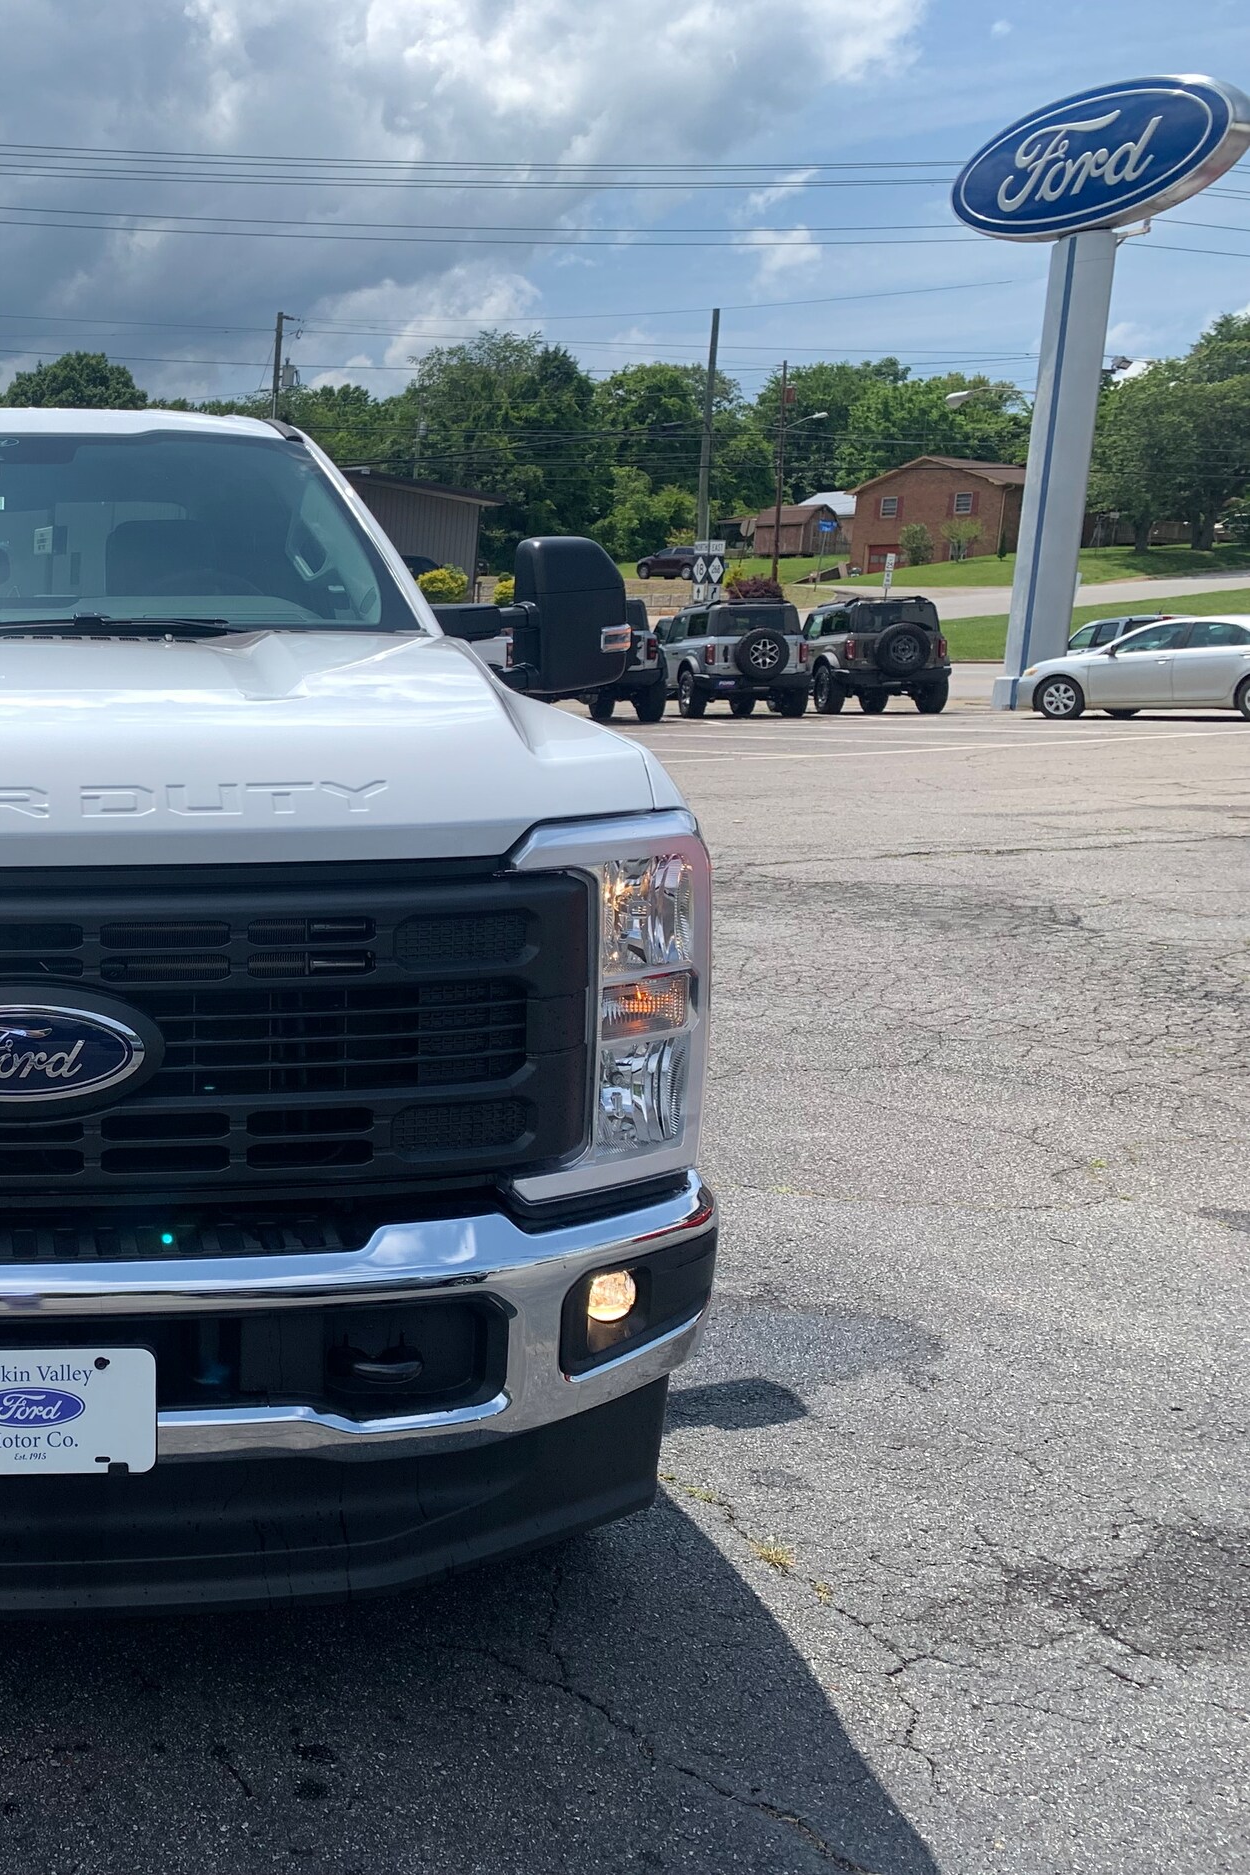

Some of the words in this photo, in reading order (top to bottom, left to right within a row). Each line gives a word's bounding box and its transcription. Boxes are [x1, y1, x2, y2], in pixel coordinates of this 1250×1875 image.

[997, 109, 1164, 213] Ford
[711, 543, 724, 552] EAST
[696, 563, 704, 576] 18
[78, 779, 389, 818] DUTY
[36, 1364, 94, 1387] Valley
[46, 1431, 79, 1448] Co.
[13, 1452, 28, 1461] Est.
[29, 1452, 47, 1460] 1915
